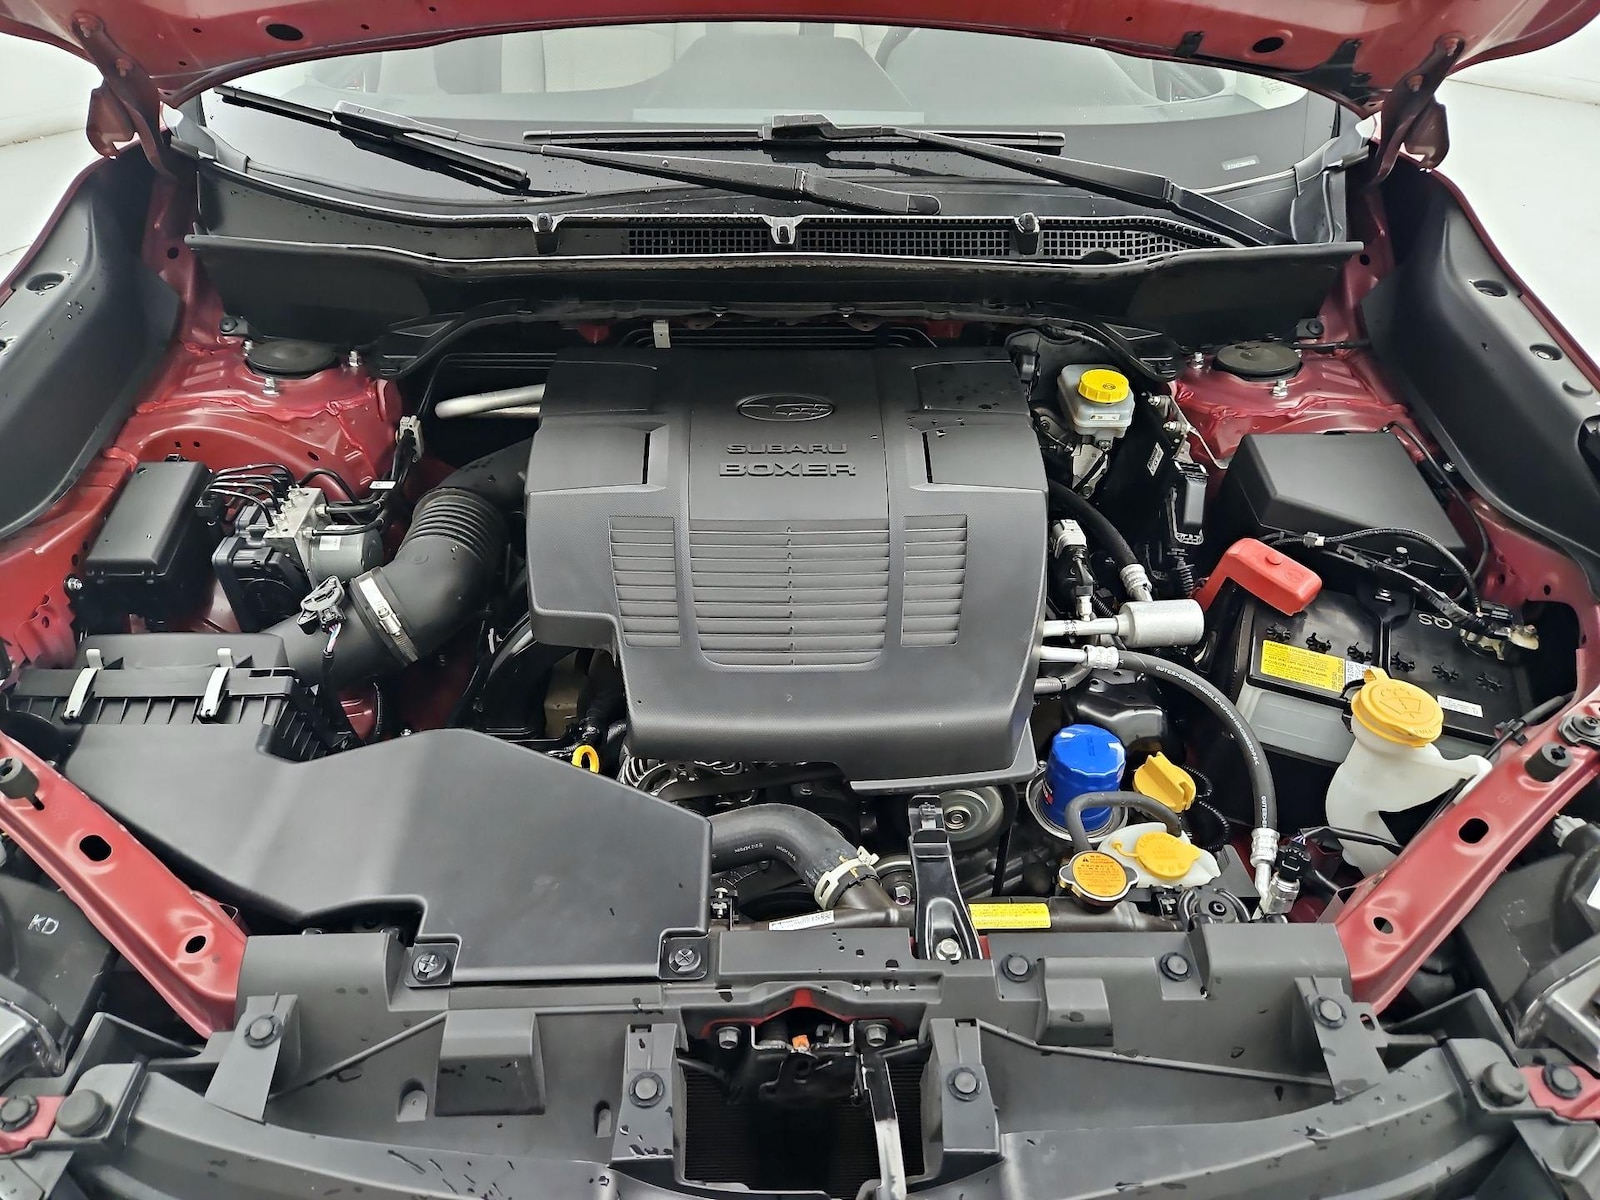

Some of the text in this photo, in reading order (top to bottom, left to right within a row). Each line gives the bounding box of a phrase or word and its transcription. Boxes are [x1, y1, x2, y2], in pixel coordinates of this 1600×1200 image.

[726, 443, 848, 455] SUBARU
[719, 462, 857, 477] BOXER
[28, 913, 60, 935] KD
